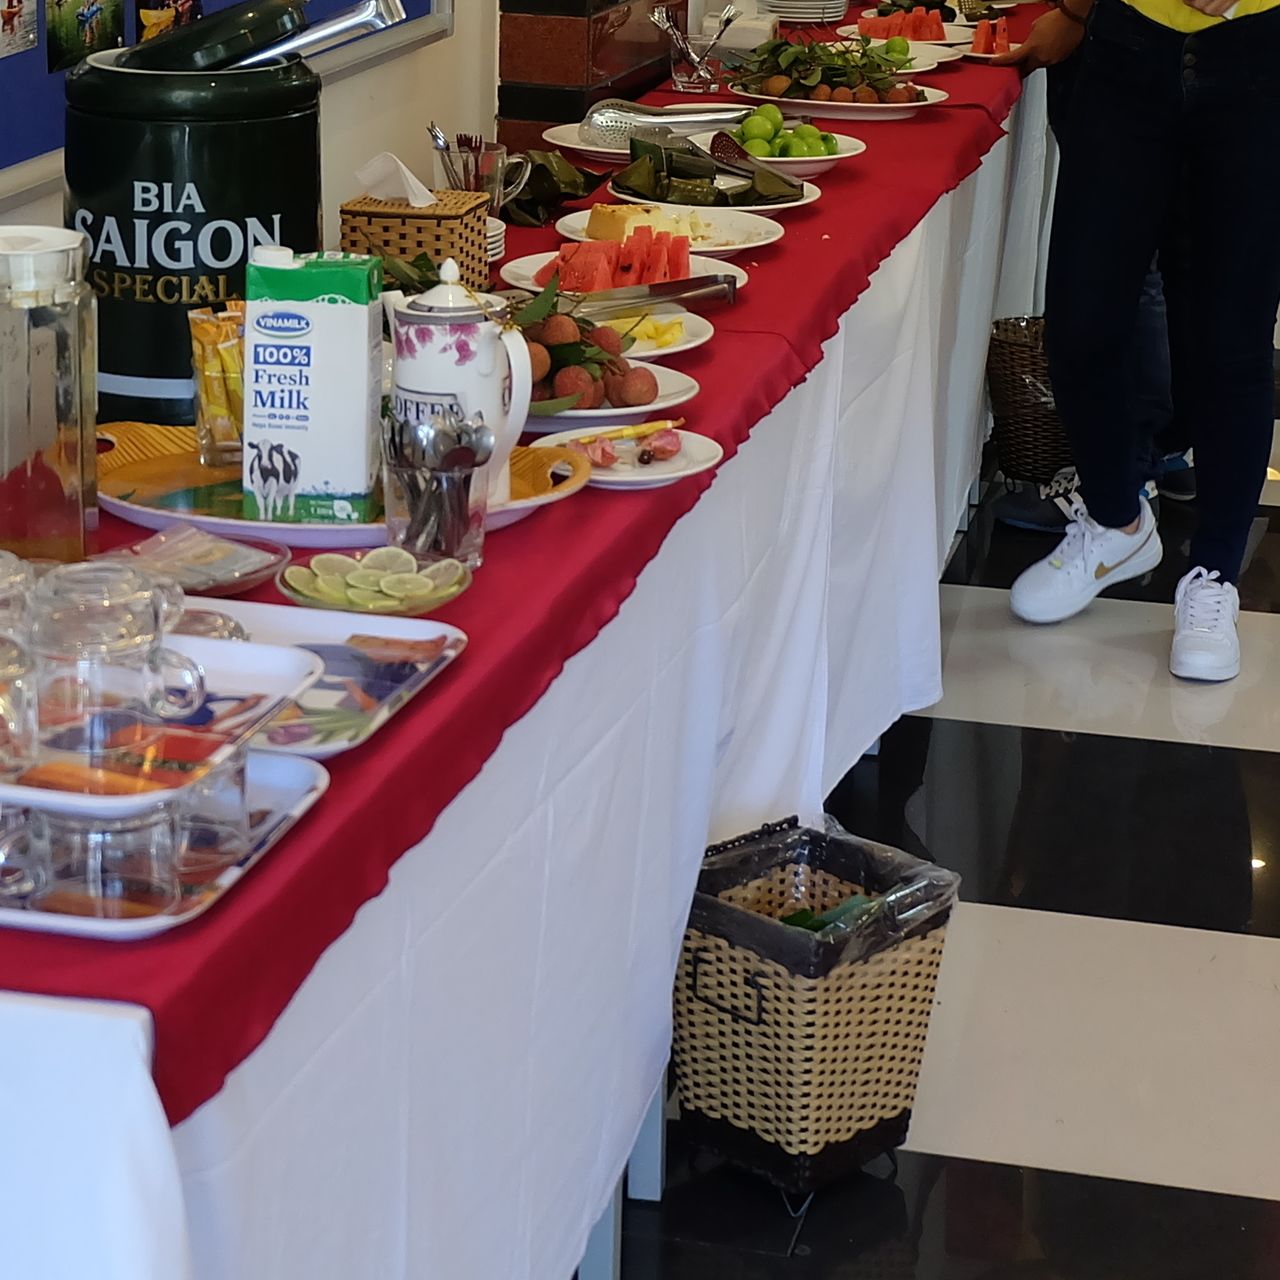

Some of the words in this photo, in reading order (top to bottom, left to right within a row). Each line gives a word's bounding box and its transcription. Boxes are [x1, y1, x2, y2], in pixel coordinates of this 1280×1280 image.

[133, 181, 206, 213] BIA
[75, 208, 282, 269] SAIGON
[94, 271, 240, 304] SPECIAL
[259, 318, 308, 329] VINAMILK
[256, 346, 309, 364] 100%
[253, 369, 310, 386] Fresh
[253, 389, 310, 410] Milk
[395, 395, 461, 421] OFFEE
